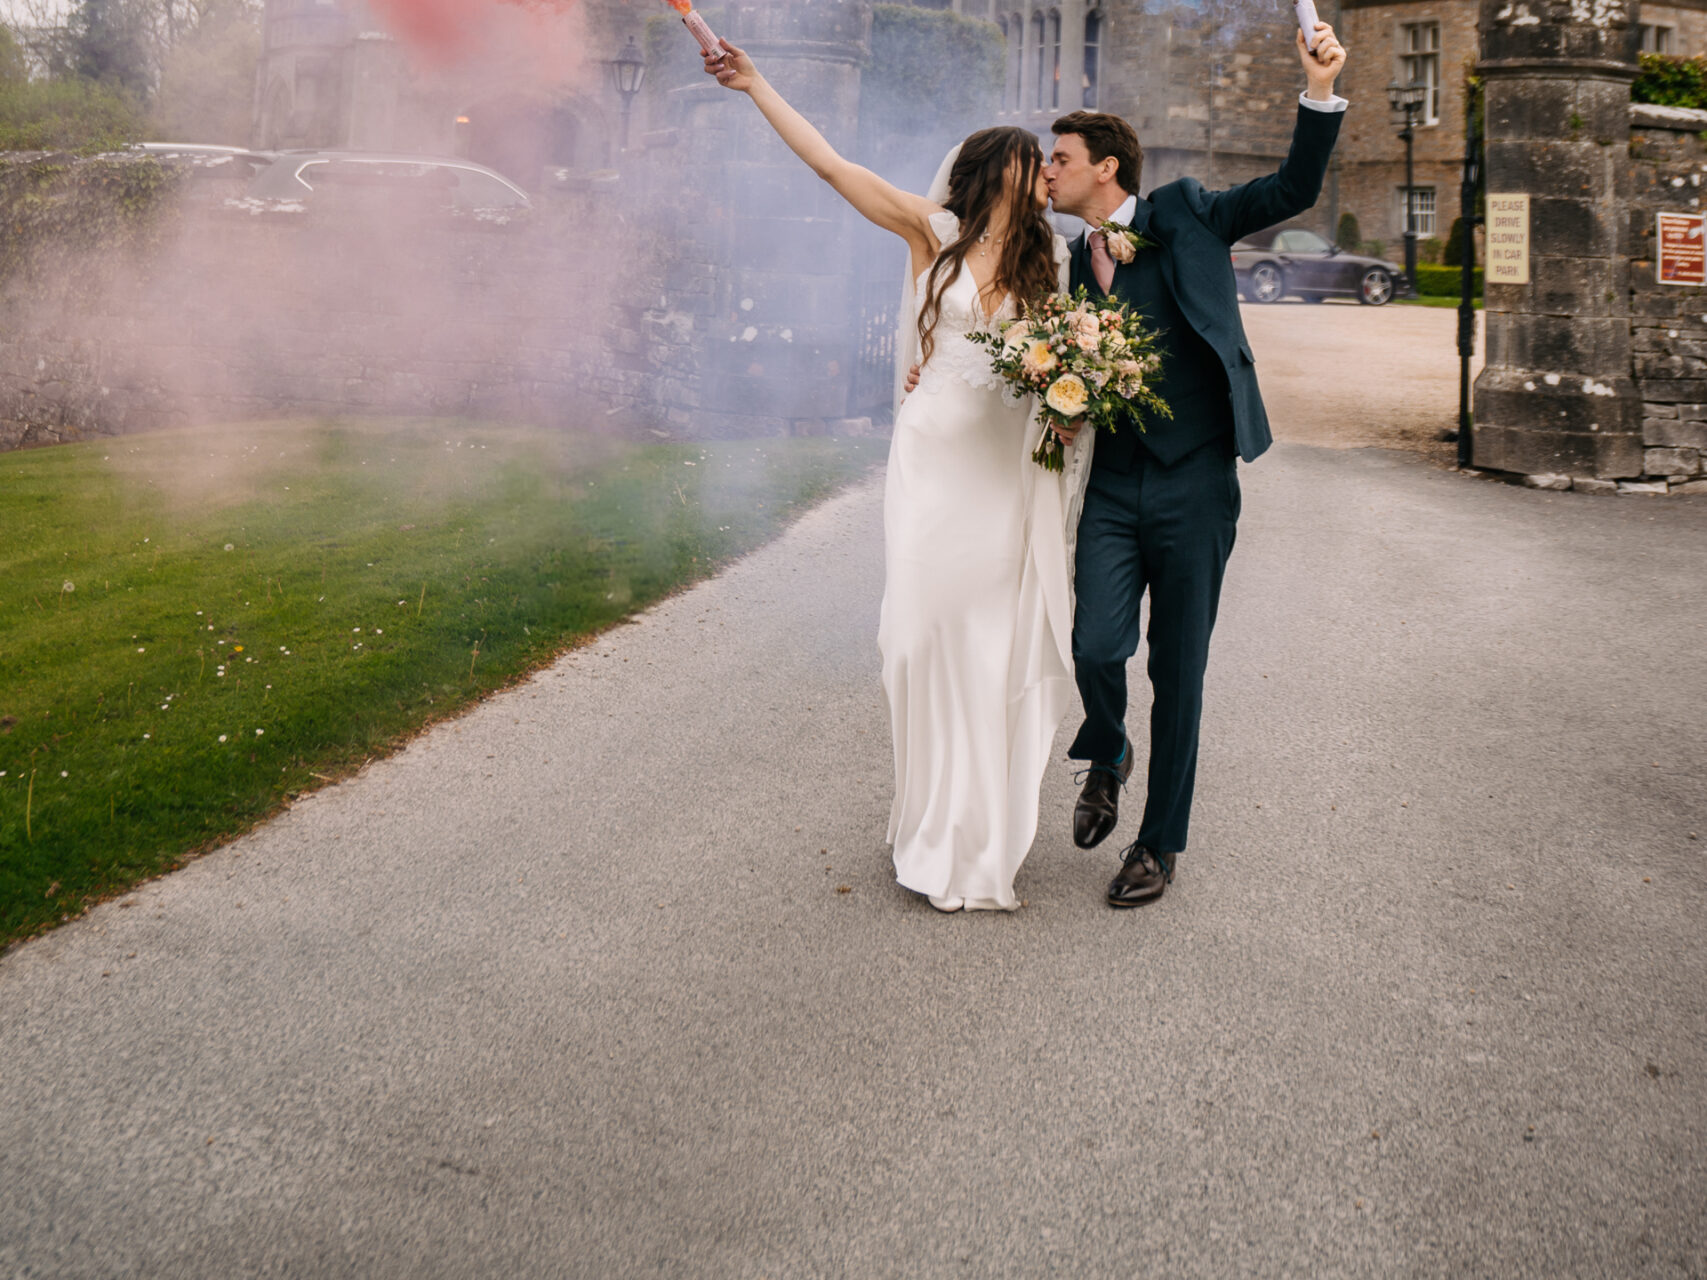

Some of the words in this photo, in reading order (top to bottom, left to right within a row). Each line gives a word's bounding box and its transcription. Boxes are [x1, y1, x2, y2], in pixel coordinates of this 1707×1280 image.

[1491, 201, 1525, 211] PLEASE
[1495, 217, 1521, 228] DRIVE
[1490, 233, 1525, 244] SLOWLY
[1504, 249, 1522, 260] CAR
[1496, 266, 1520, 277] PARK
